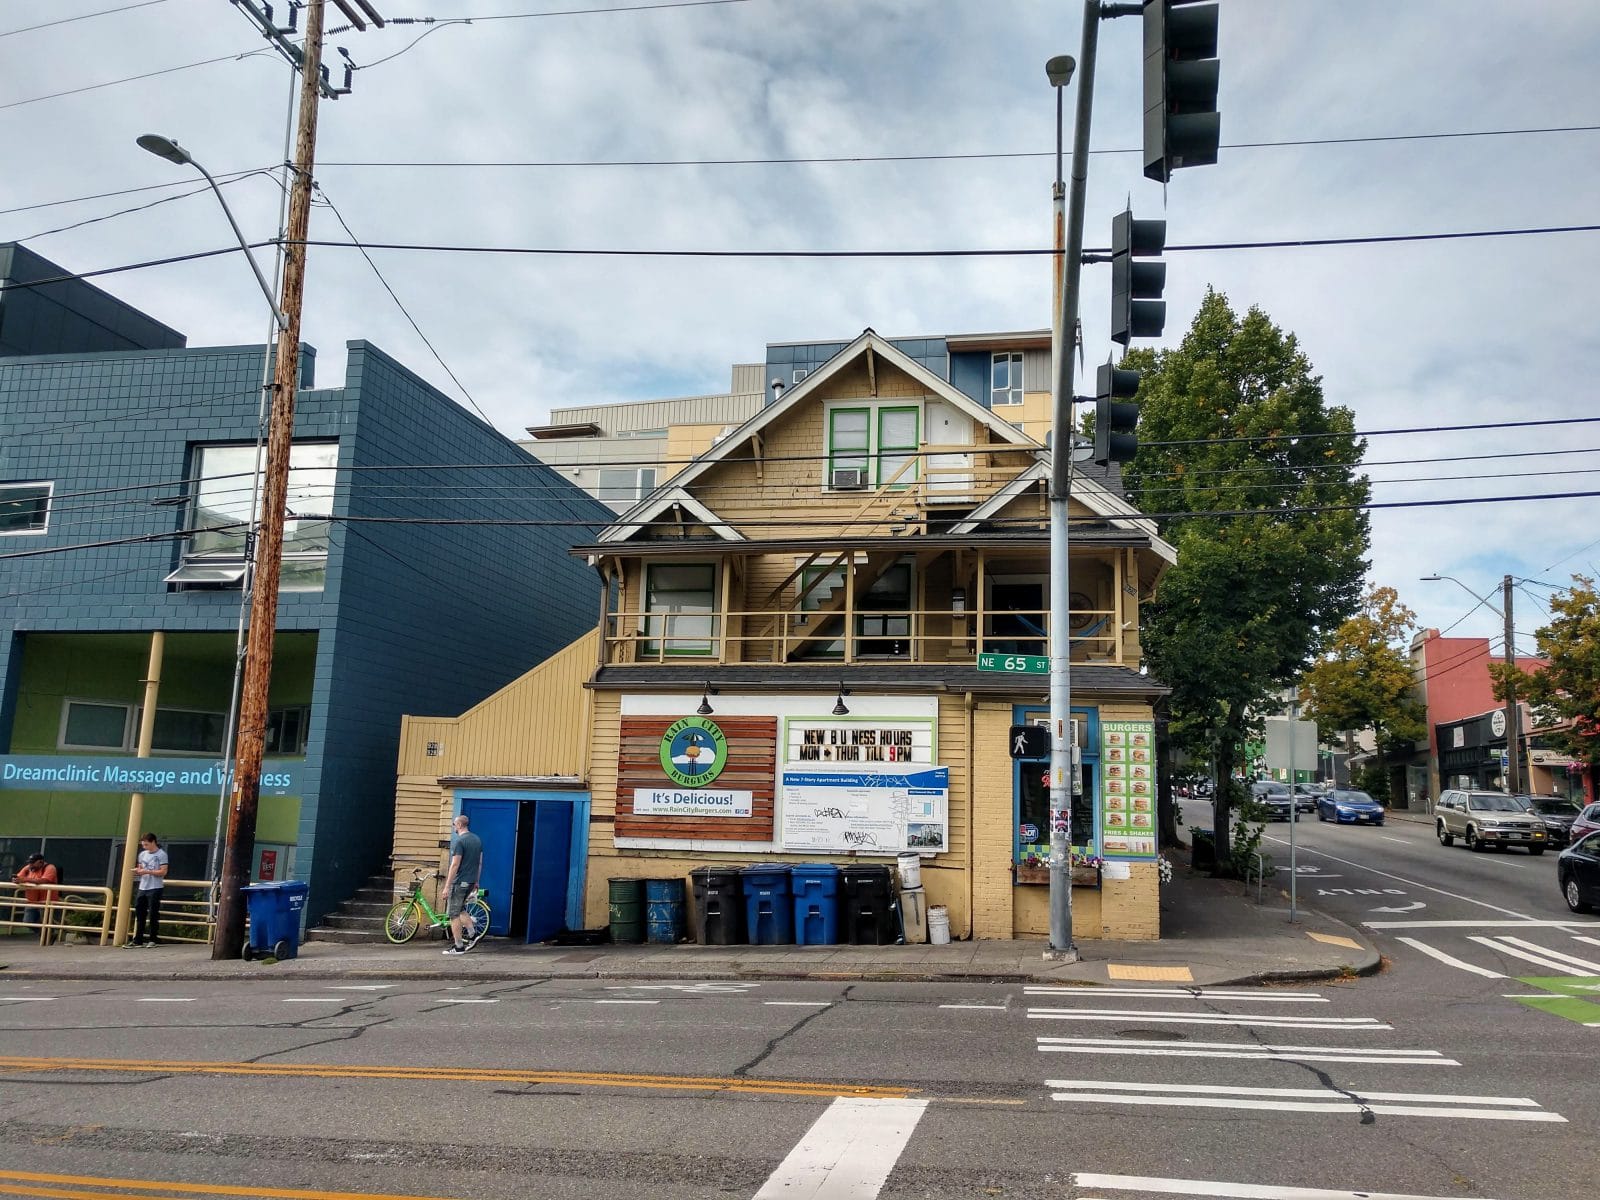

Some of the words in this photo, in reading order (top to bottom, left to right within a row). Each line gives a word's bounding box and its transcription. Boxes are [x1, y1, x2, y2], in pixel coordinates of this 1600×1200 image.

[246, 533, 254, 560] 315
[981, 657, 995, 667] NE
[1004, 657, 1027, 671] 65
[1036, 661, 1046, 669] ST
[664, 718, 689, 743] RAIN
[701, 720, 724, 742] CITY
[1103, 723, 1152, 732] BURGERS
[804, 729, 825, 745] NEW
[880, 730, 912, 746] HOURS
[799, 745, 820, 761] MON
[835, 745, 859, 761] THUR
[889, 745, 912, 762] 9PM
[3, 763, 101, 783] Dreamclinic
[103, 765, 176, 787] Massage
[180, 768, 213, 785] and
[671, 770, 715, 785] BURGERS
[652, 792, 670, 804] It's
[673, 792, 733, 805] Delicious!
[652, 806, 732, 815] www.RainCityBurgers.com
